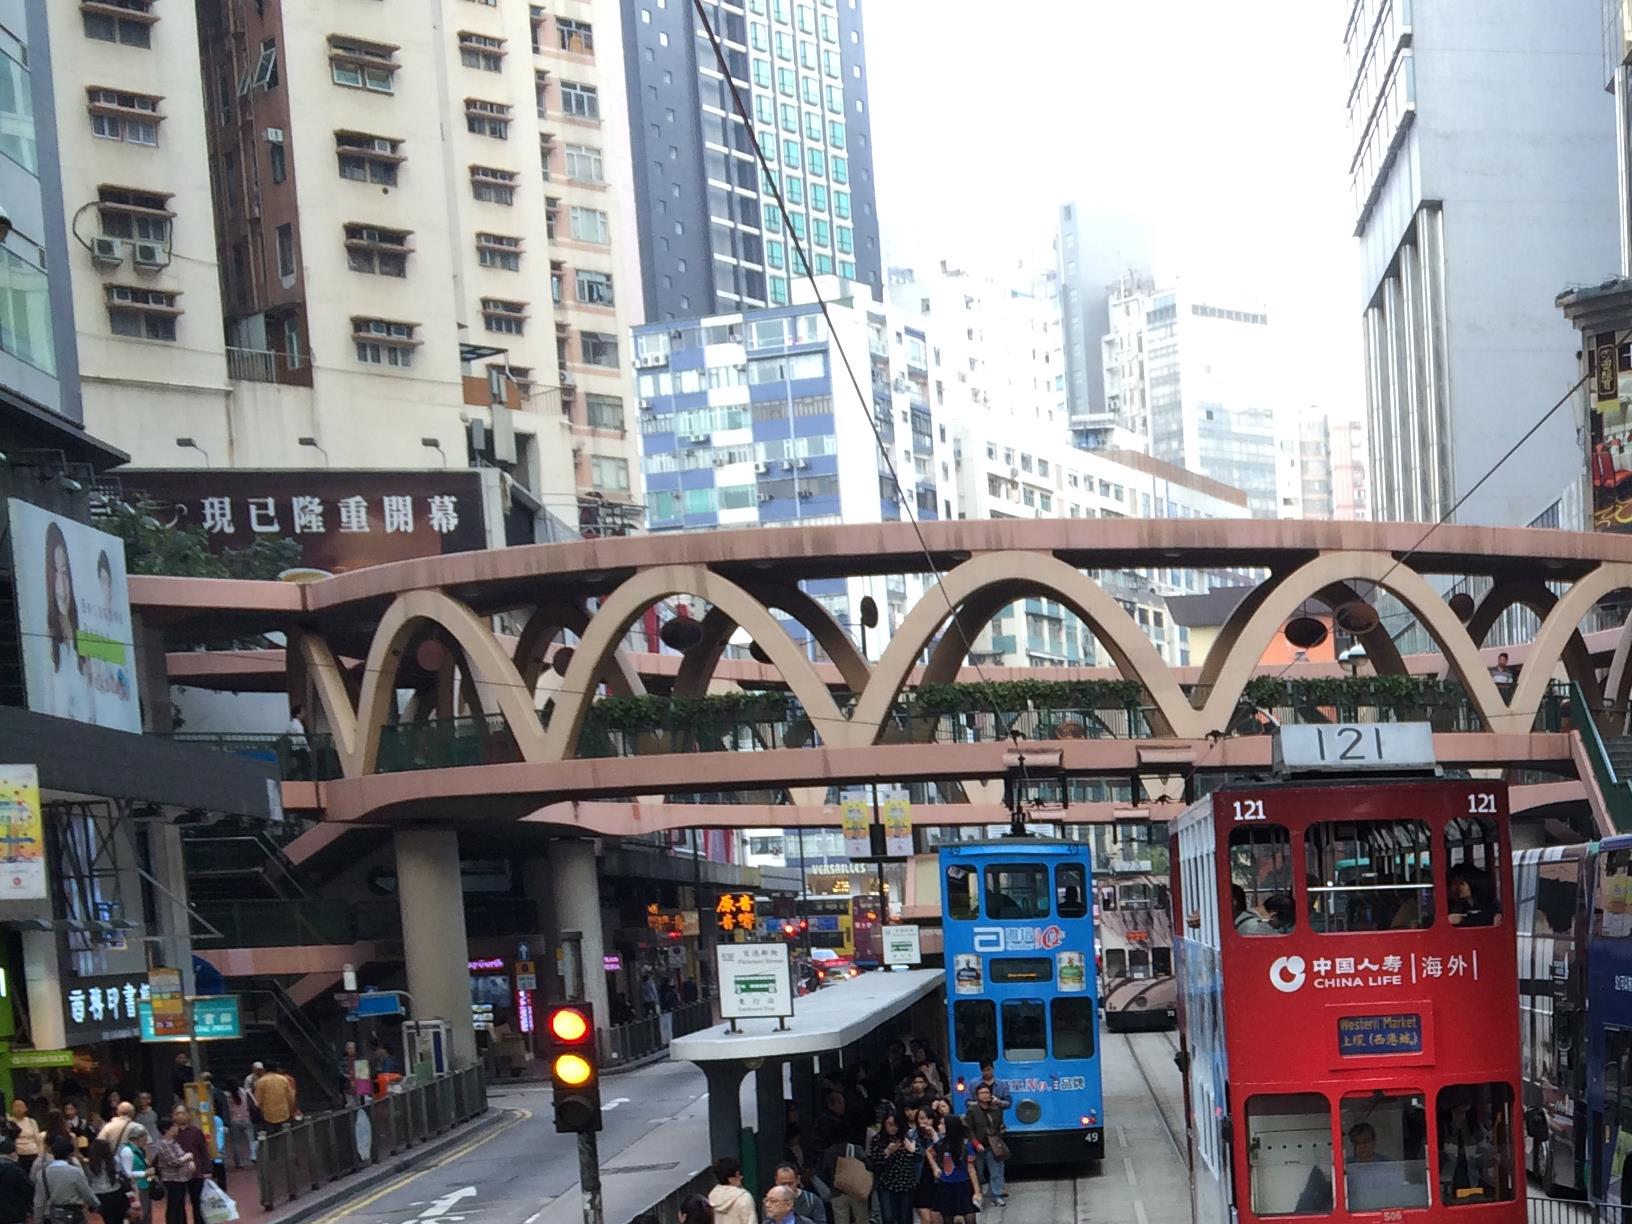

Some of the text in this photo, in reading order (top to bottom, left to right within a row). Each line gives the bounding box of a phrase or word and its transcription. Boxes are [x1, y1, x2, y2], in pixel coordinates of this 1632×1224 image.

[200, 494, 460, 535] 現已隆重開幕
[1316, 727, 1383, 761] 121
[1232, 799, 1267, 821] 121
[1467, 793, 1498, 815] 121
[811, 862, 867, 875] VERSAILLES
[1312, 954, 1469, 979] 中国人寿 海外
[1313, 975, 1403, 989] CHINA LIFE
[1339, 1015, 1417, 1032] Western Market
[1084, 1132, 1099, 1143] 49
